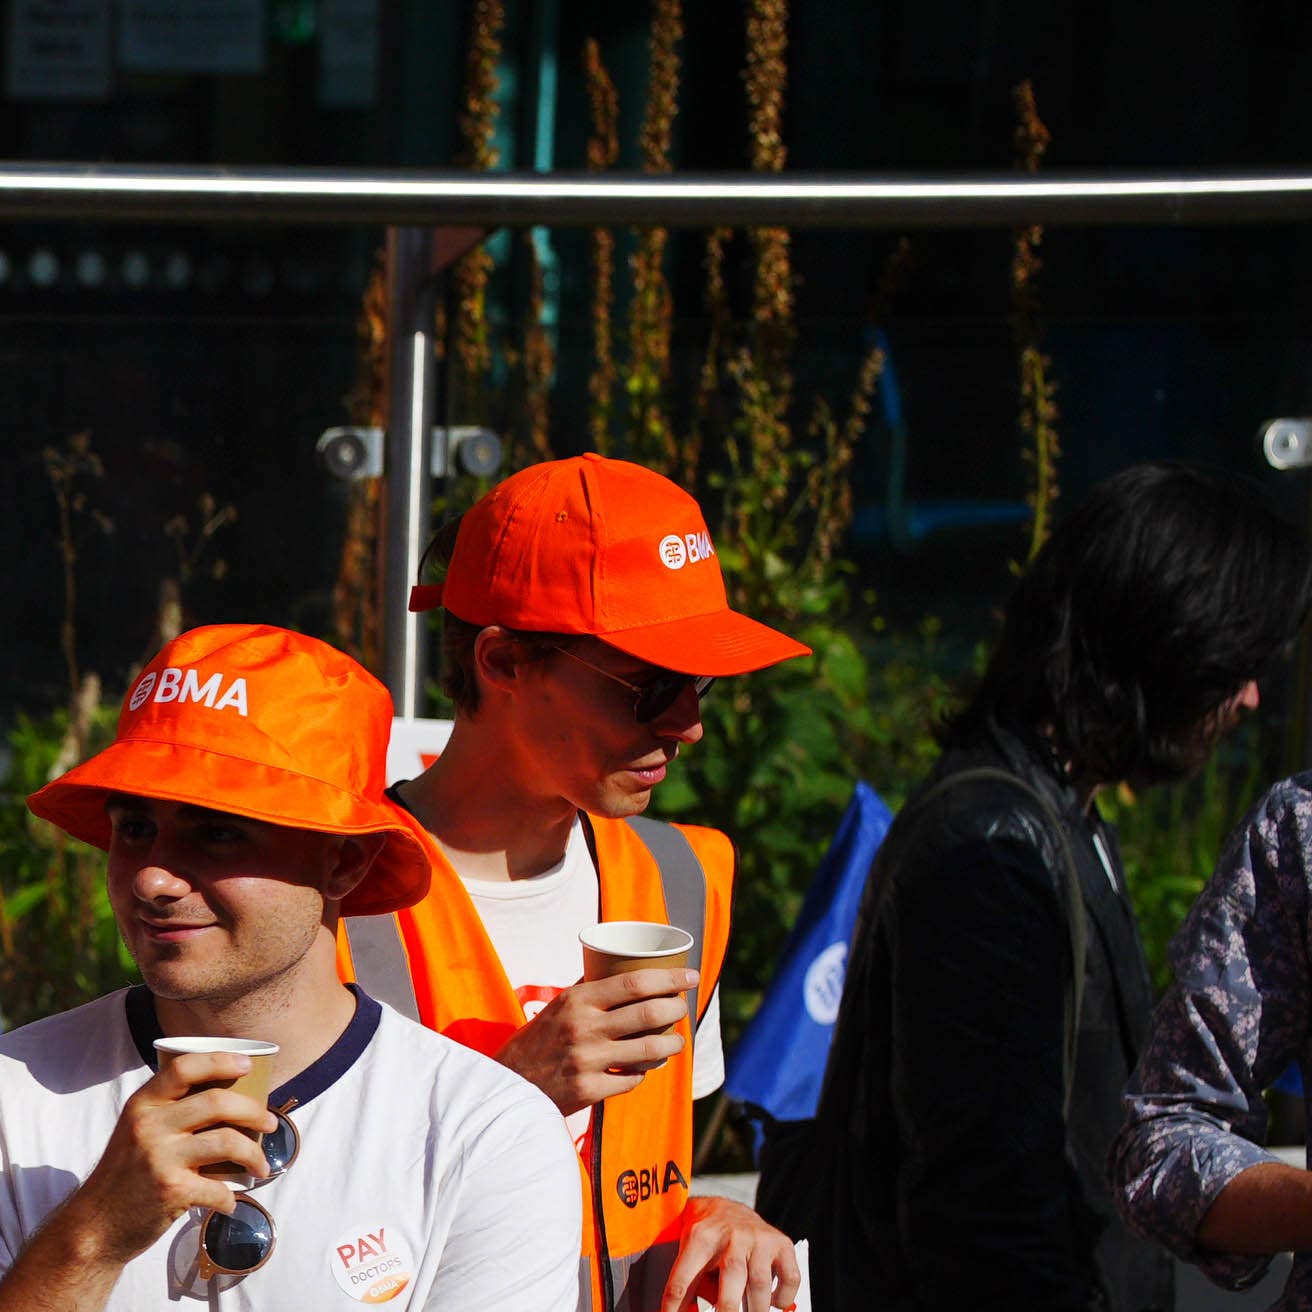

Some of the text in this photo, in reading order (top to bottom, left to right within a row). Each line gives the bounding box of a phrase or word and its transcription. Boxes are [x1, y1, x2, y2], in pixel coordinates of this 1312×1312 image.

[153, 667, 248, 717] BMA
[336, 1228, 387, 1269] PAY
[350, 1257, 401, 1285] DOCTORS
